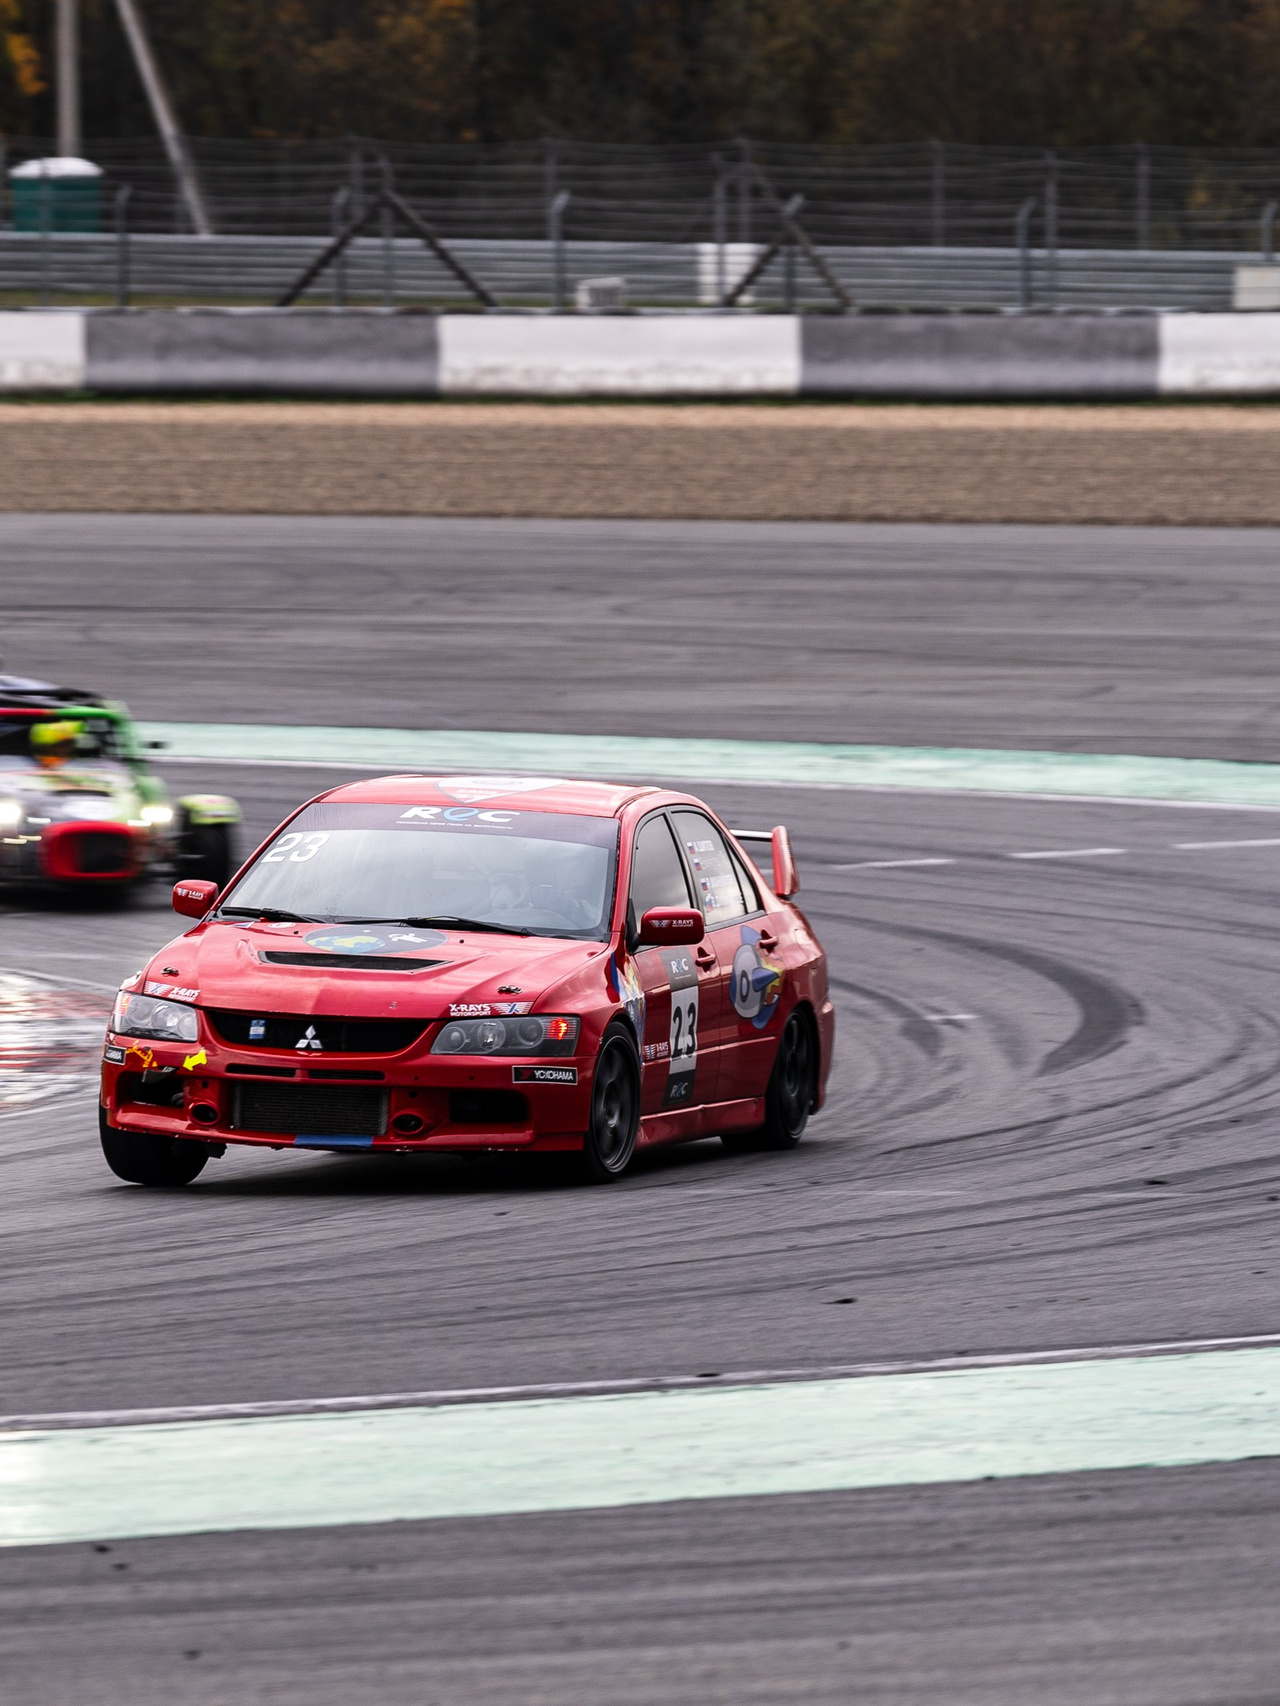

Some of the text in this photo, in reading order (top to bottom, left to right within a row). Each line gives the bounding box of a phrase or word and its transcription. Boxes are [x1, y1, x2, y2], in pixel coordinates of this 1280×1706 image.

[261, 832, 330, 863] 23
[449, 1003, 491, 1012] X-RAYS
[672, 1002, 696, 1059] 23
[534, 1069, 574, 1081] YOKOHAMA
